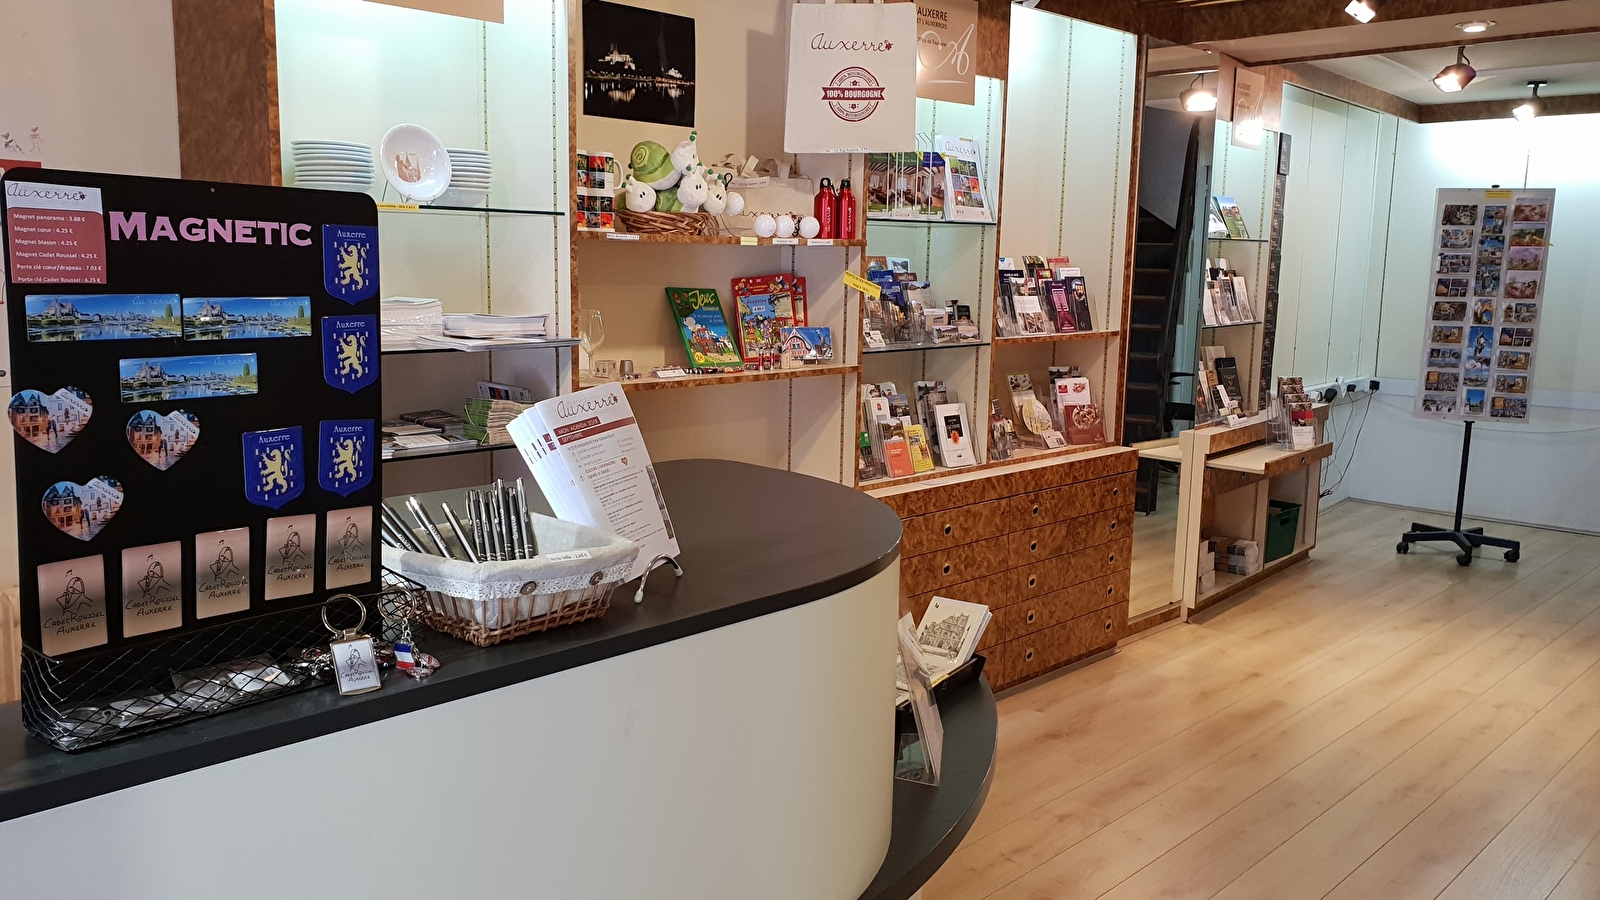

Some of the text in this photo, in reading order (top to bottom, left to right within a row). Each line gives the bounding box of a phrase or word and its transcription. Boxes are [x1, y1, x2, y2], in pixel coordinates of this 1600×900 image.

[917, 6, 948, 21] AUXERRE
[826, 90, 881, 98] 100% BOURGOGNE
[109, 211, 312, 246] MAGNETIC
[337, 230, 366, 239] Auxerre
[336, 320, 365, 328] Auxerre
[557, 396, 616, 418] Auxerre
[570, 423, 587, 431] AGENDA
[258, 434, 290, 444] Auxerre
[336, 563, 364, 571] AUXERRE
[276, 573, 306, 581] AUXERRE
[208, 589, 241, 599] AUXERRE
[137, 605, 172, 616] AUXERRE
[57, 622, 96, 635] AUXERRE
